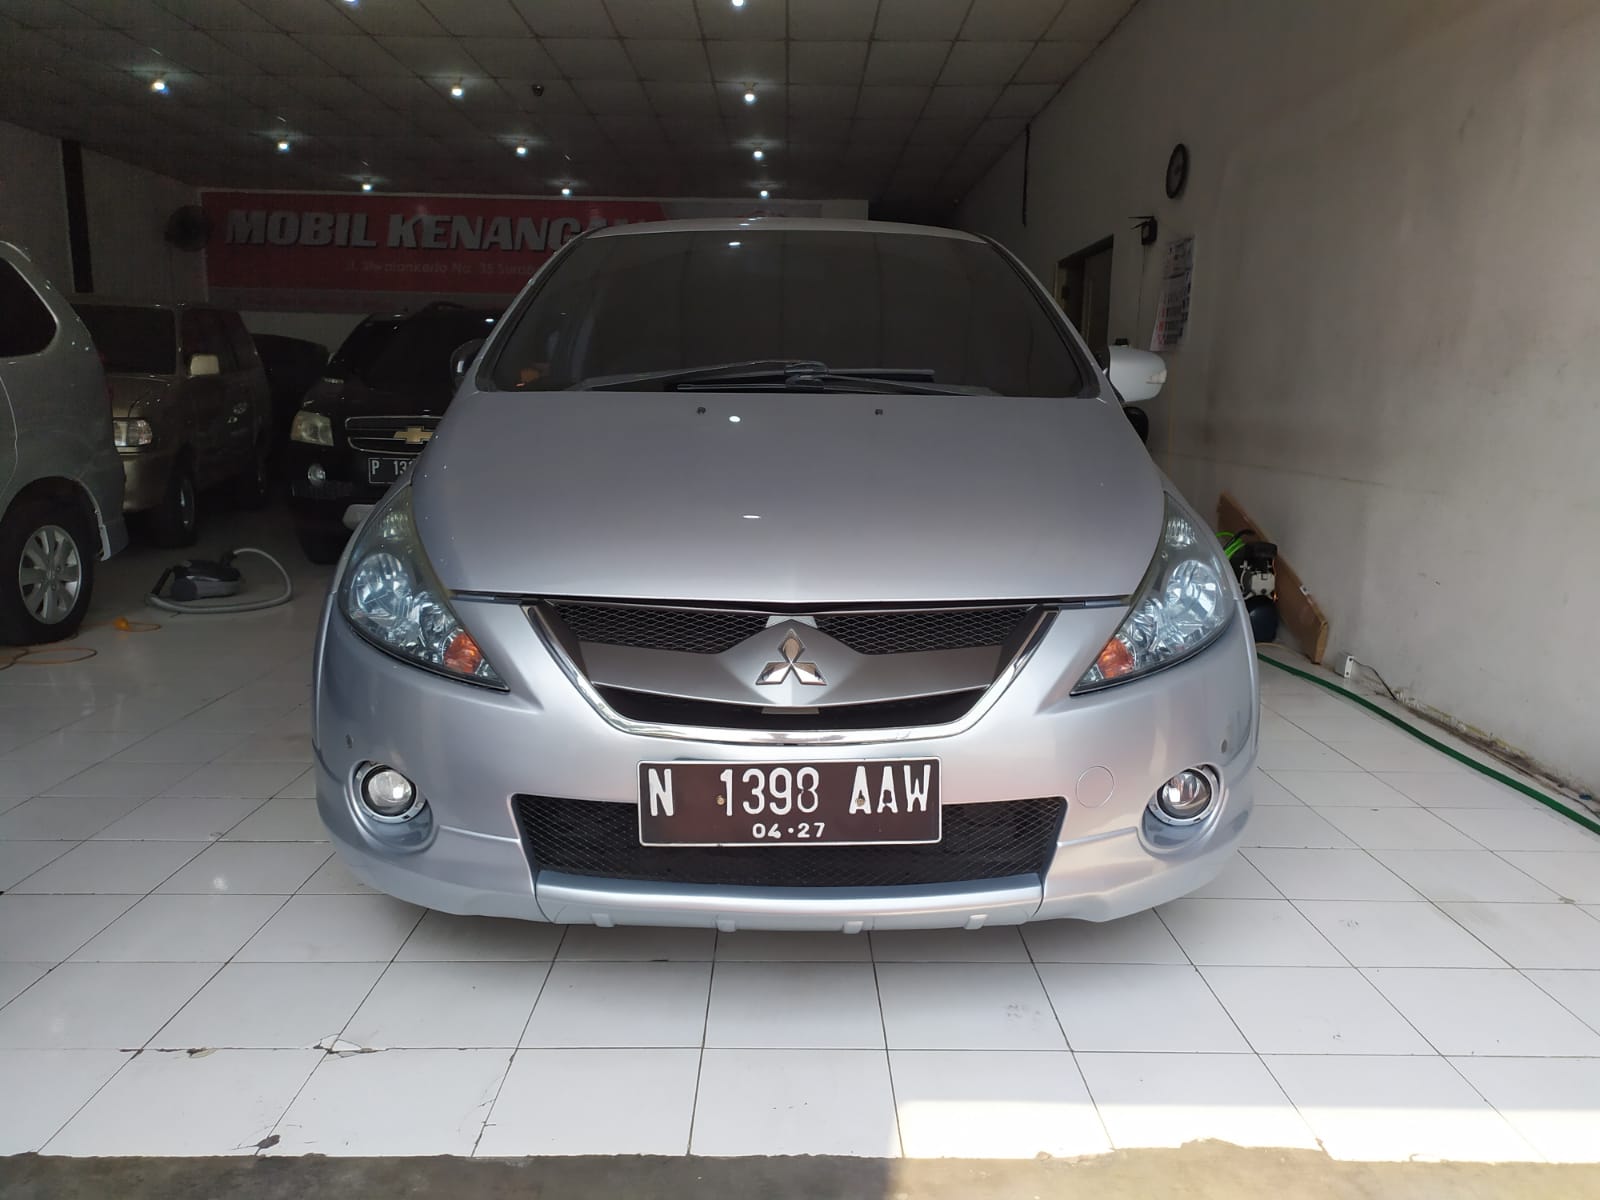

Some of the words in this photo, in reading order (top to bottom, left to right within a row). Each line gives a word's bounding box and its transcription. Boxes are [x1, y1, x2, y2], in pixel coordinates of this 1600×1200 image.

[225, 210, 377, 247] MOBIL
[386, 213, 642, 253] KENANG
[371, 460, 380, 475] P
[393, 460, 413, 476] 13
[648, 767, 674, 816] N
[720, 767, 820, 816] 1398
[849, 764, 931, 815] AAW
